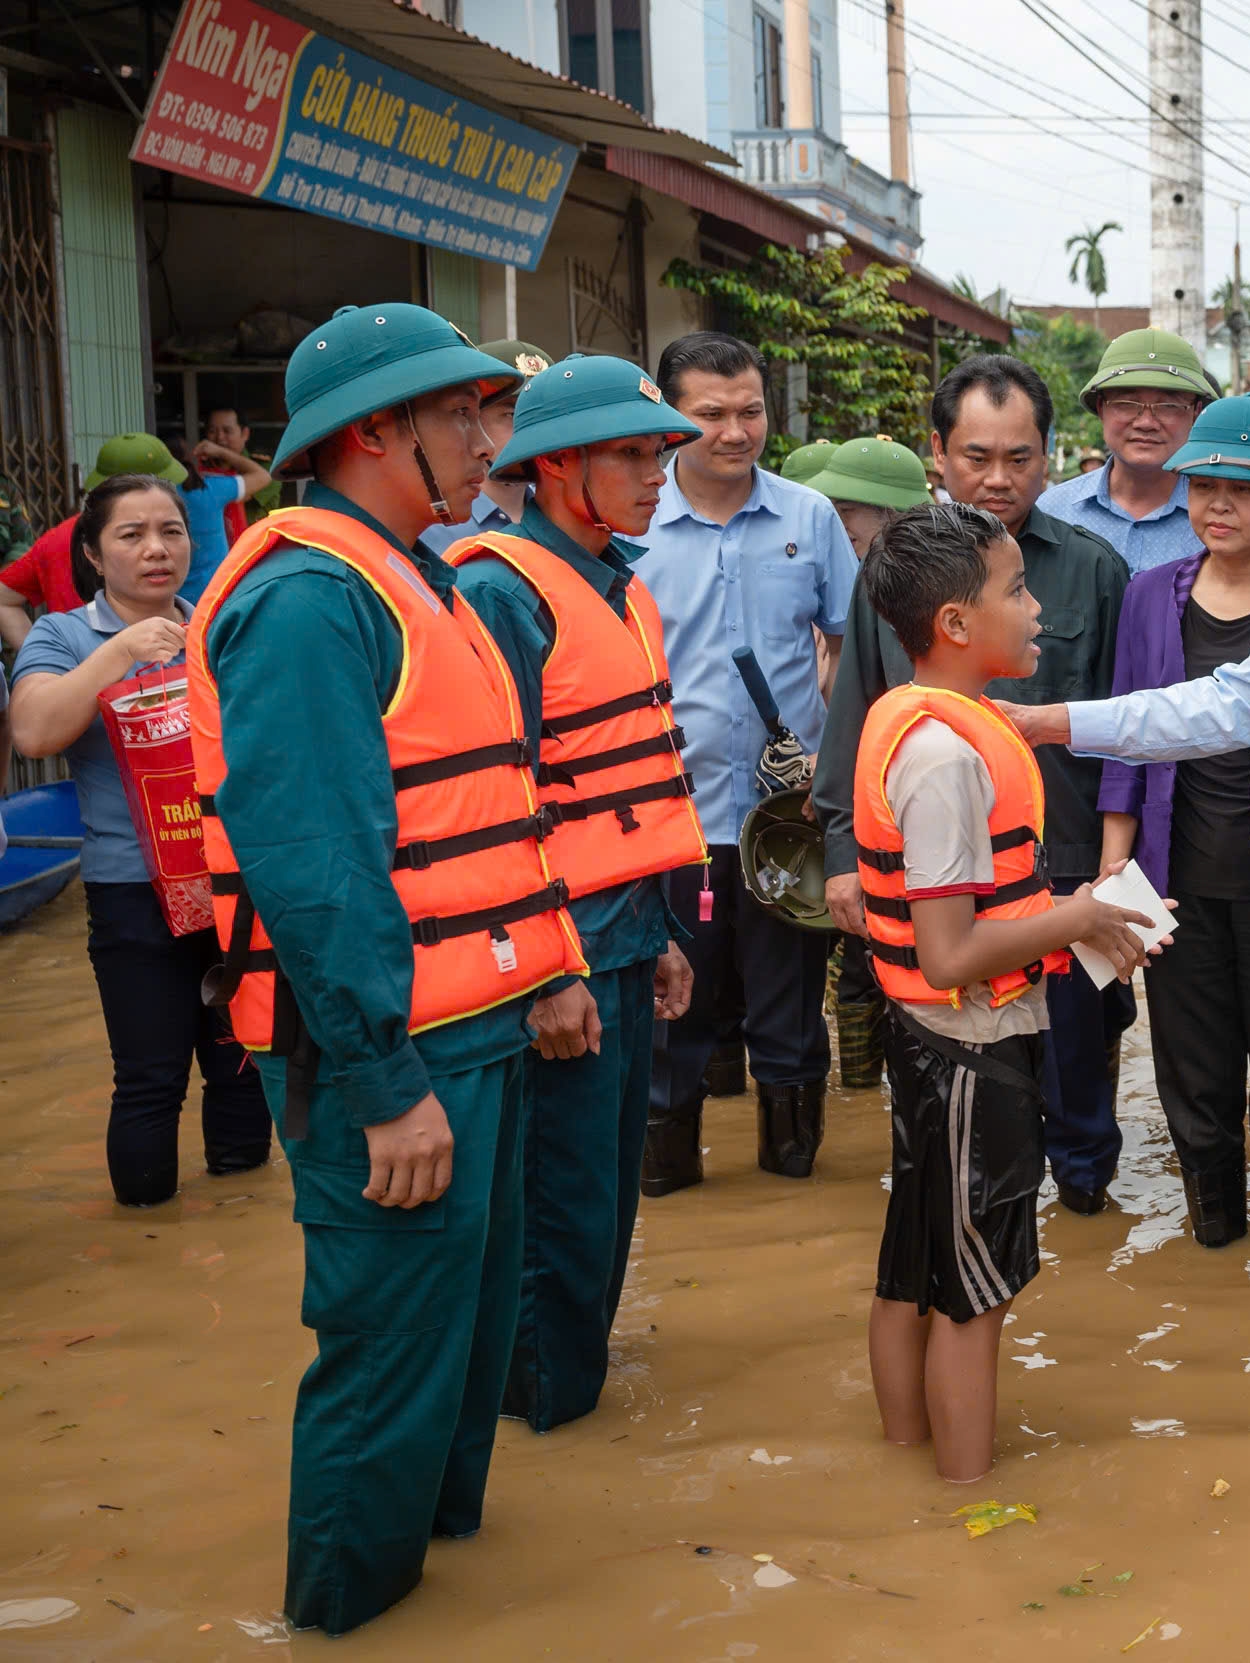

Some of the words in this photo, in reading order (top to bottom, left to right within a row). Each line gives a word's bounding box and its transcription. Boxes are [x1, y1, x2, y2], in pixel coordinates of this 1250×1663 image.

[176, 0, 237, 78] Kim
[231, 19, 289, 112] Nga
[158, 90, 186, 123] ĐT:
[185, 100, 221, 134] 0394
[217, 112, 246, 143] 506
[242, 121, 269, 151] 873
[301, 52, 352, 129] CỬA
[343, 75, 406, 149] HÀNG
[398, 101, 460, 168] THUỐC
[453, 123, 495, 180] THÚ
[485, 138, 506, 184] Y
[497, 143, 536, 195] CAO
[526, 145, 564, 203] CẤP
[170, 827, 190, 841] VIÊN
